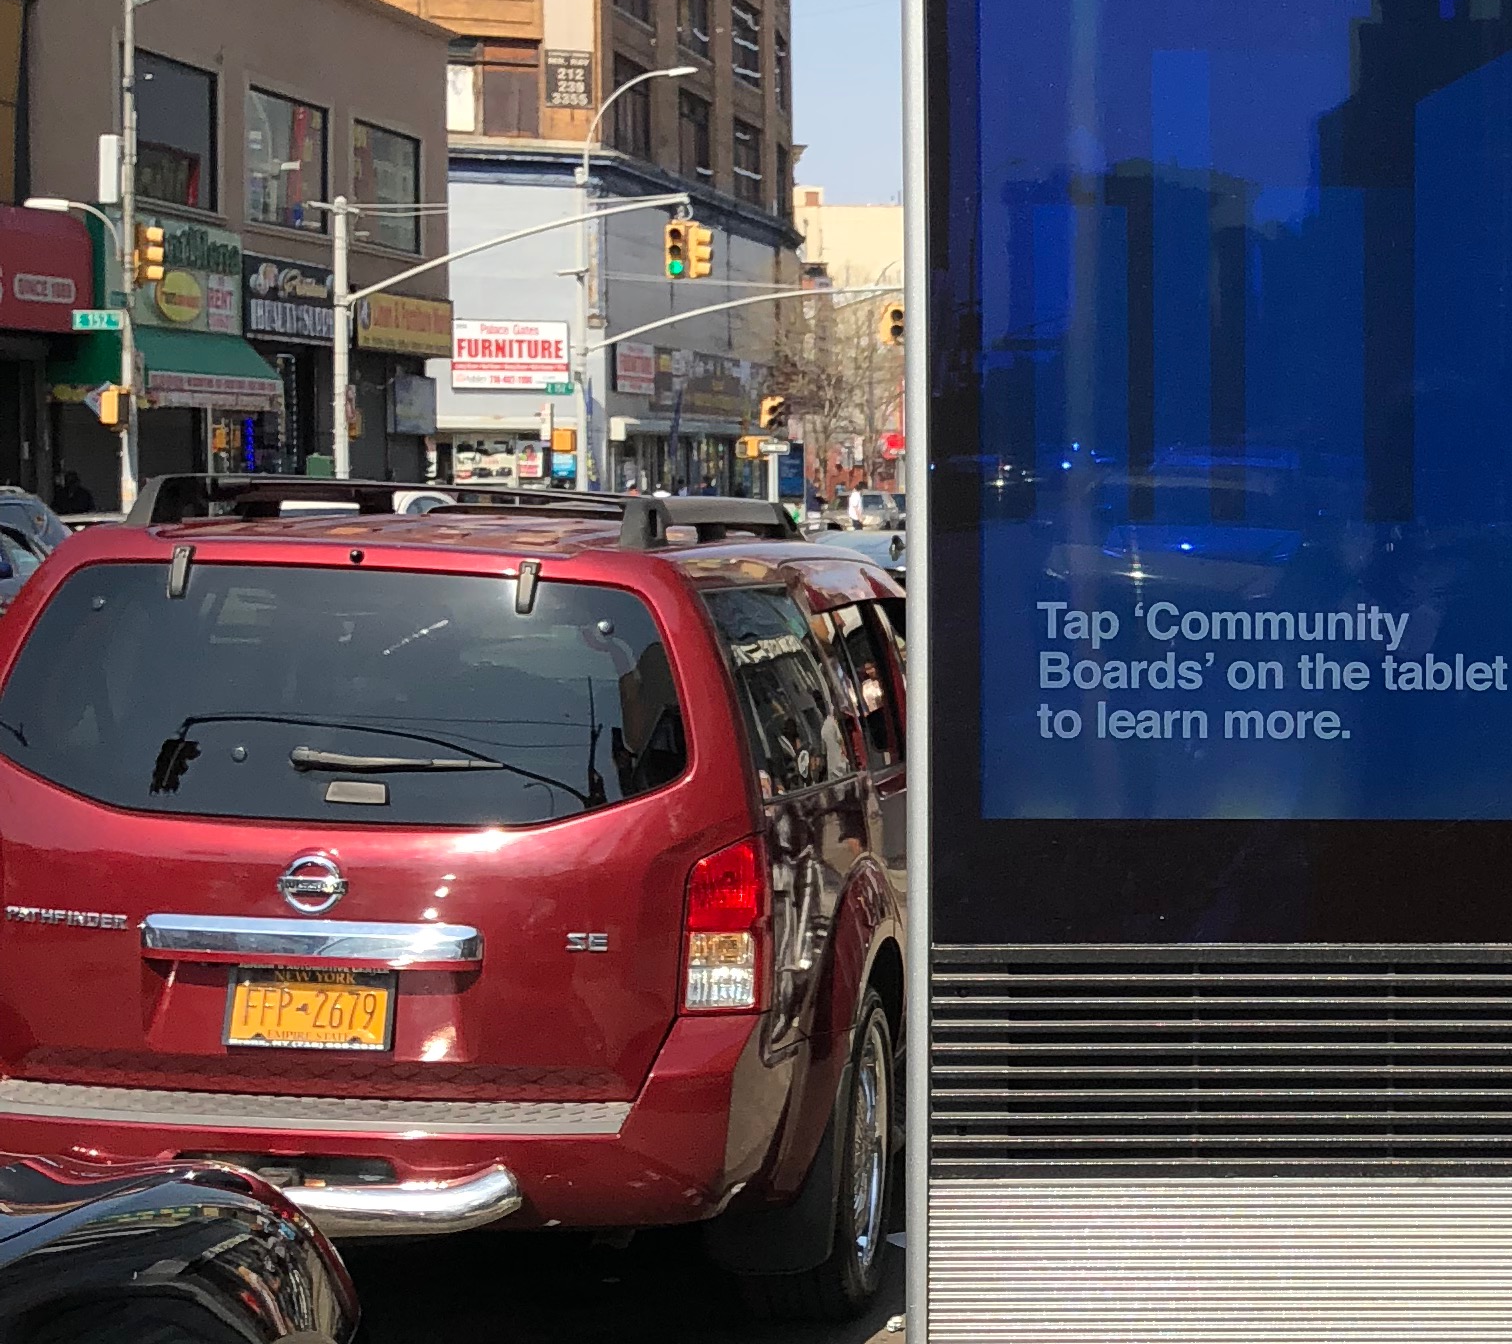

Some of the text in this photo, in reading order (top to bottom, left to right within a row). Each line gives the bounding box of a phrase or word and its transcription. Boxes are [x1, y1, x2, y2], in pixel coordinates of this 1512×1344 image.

[457, 338, 563, 358] FURNITURE
[1036, 601, 1120, 649] Tap
[1226, 658, 1284, 690] on
[1299, 653, 1370, 690] the
[1383, 654, 1508, 691] tablet
[1037, 701, 1351, 739] to learn more.
[5, 905, 128, 930] PATHFINDER
[565, 933, 608, 952] SE
[274, 971, 356, 984] NEW YORK
[267, 1030, 349, 1042] EMPIRE STATE
